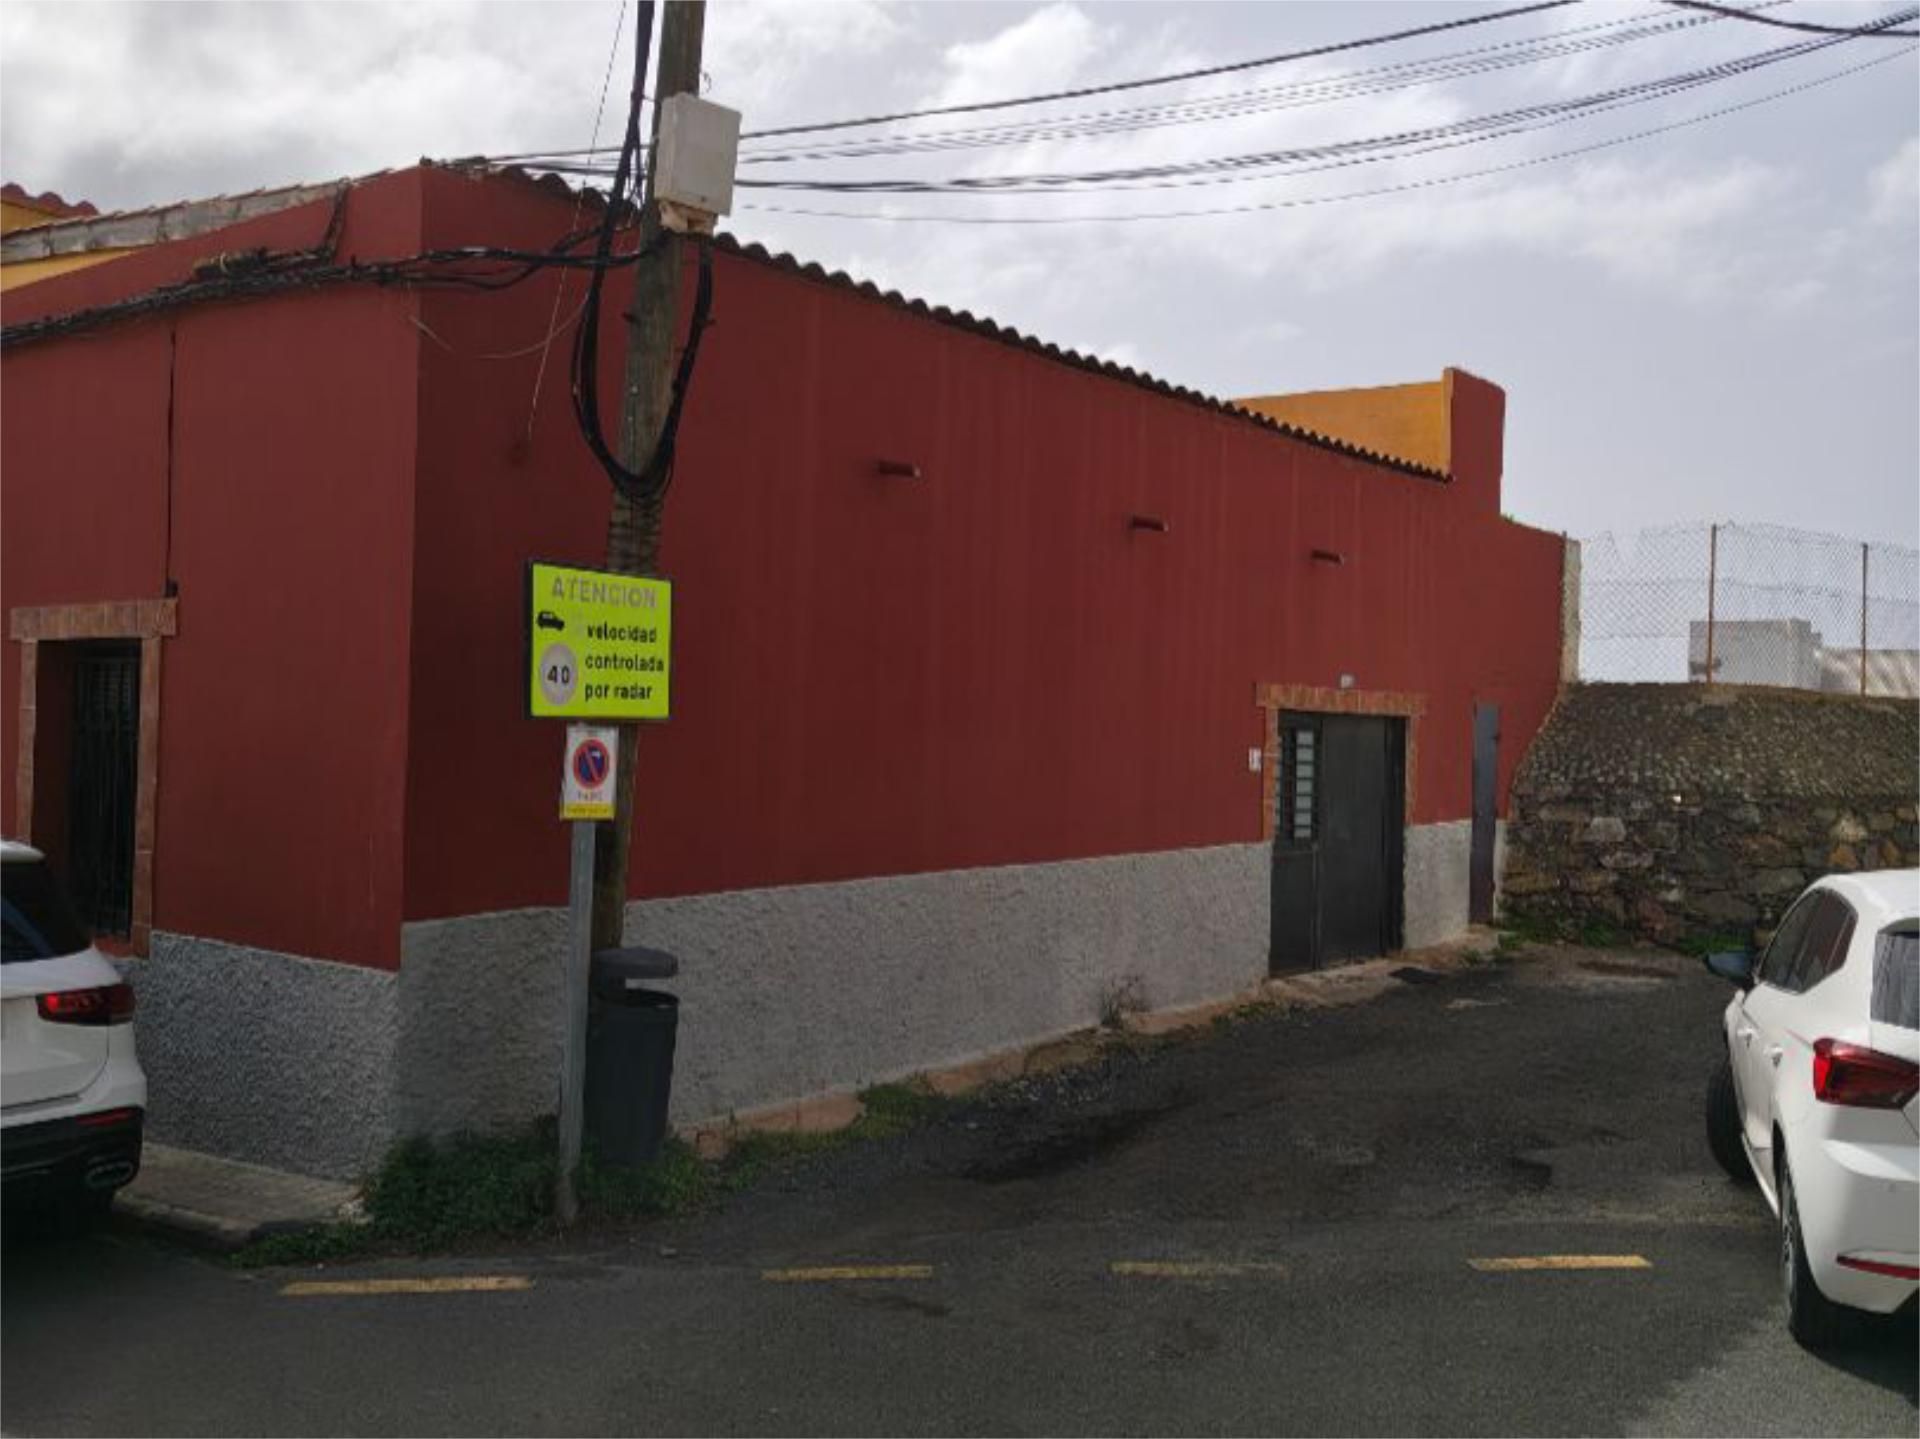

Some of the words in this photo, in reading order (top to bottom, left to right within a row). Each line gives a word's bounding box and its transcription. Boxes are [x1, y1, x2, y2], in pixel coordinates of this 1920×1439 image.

[552, 576, 657, 608] ATENCION
[587, 621, 656, 642] velocidad
[585, 653, 664, 671] controlada
[547, 665, 570, 684] 40
[585, 682, 609, 702] por
[614, 682, 652, 699] radar
